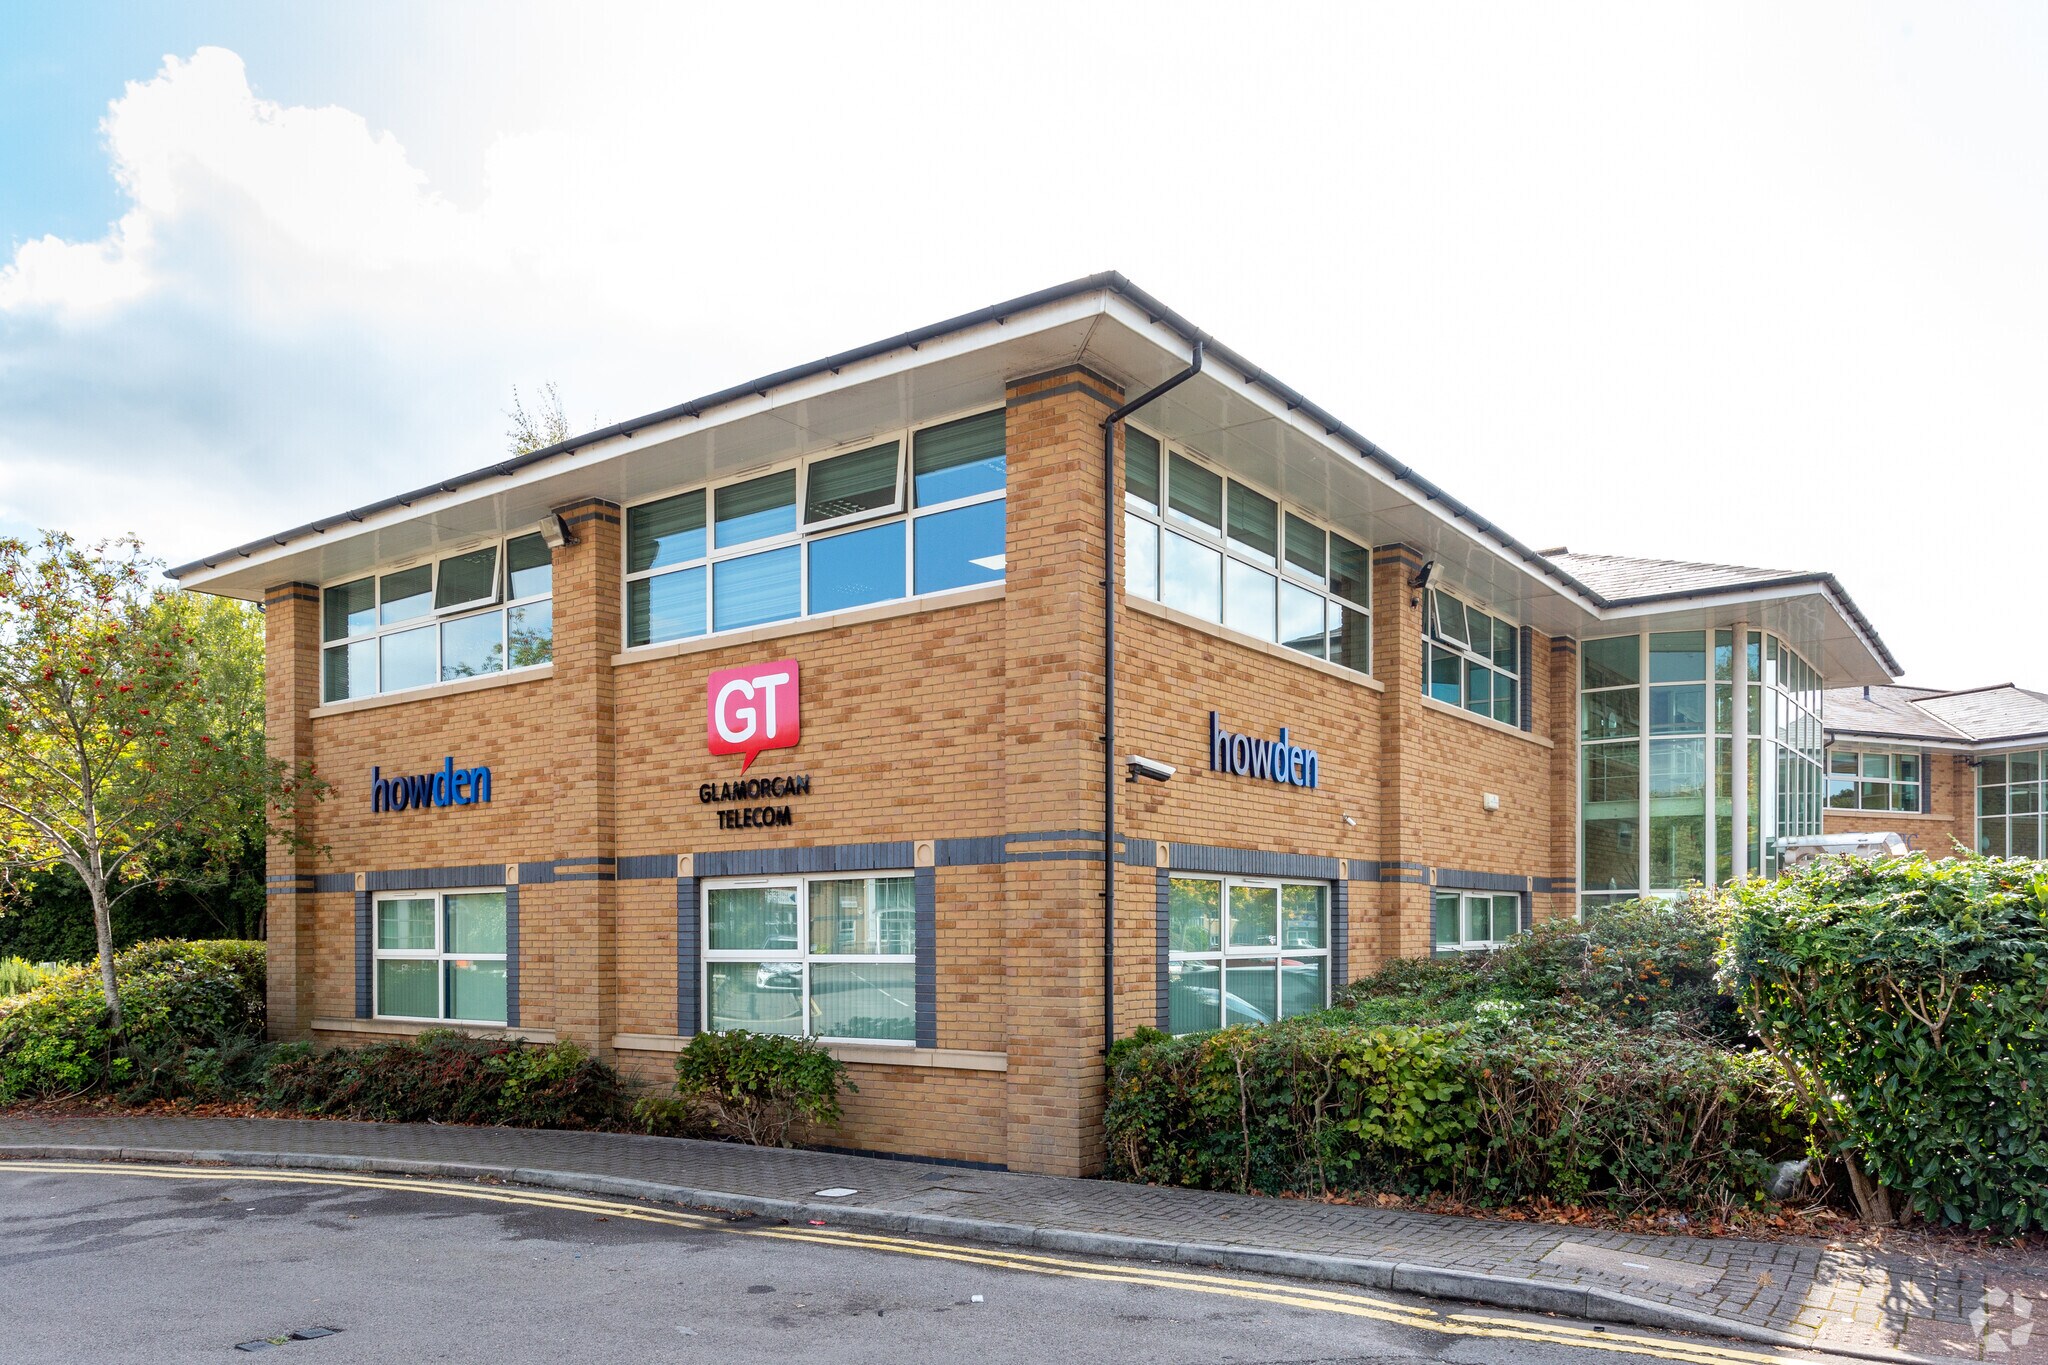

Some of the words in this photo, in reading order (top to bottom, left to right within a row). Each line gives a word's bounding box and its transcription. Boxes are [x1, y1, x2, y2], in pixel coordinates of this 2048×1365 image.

[715, 673, 789, 743] GT
[1209, 711, 1318, 788] howden
[371, 756, 491, 813] howden
[700, 774, 810, 803] GLAMORGAN
[717, 806, 792, 829] TELECOM
